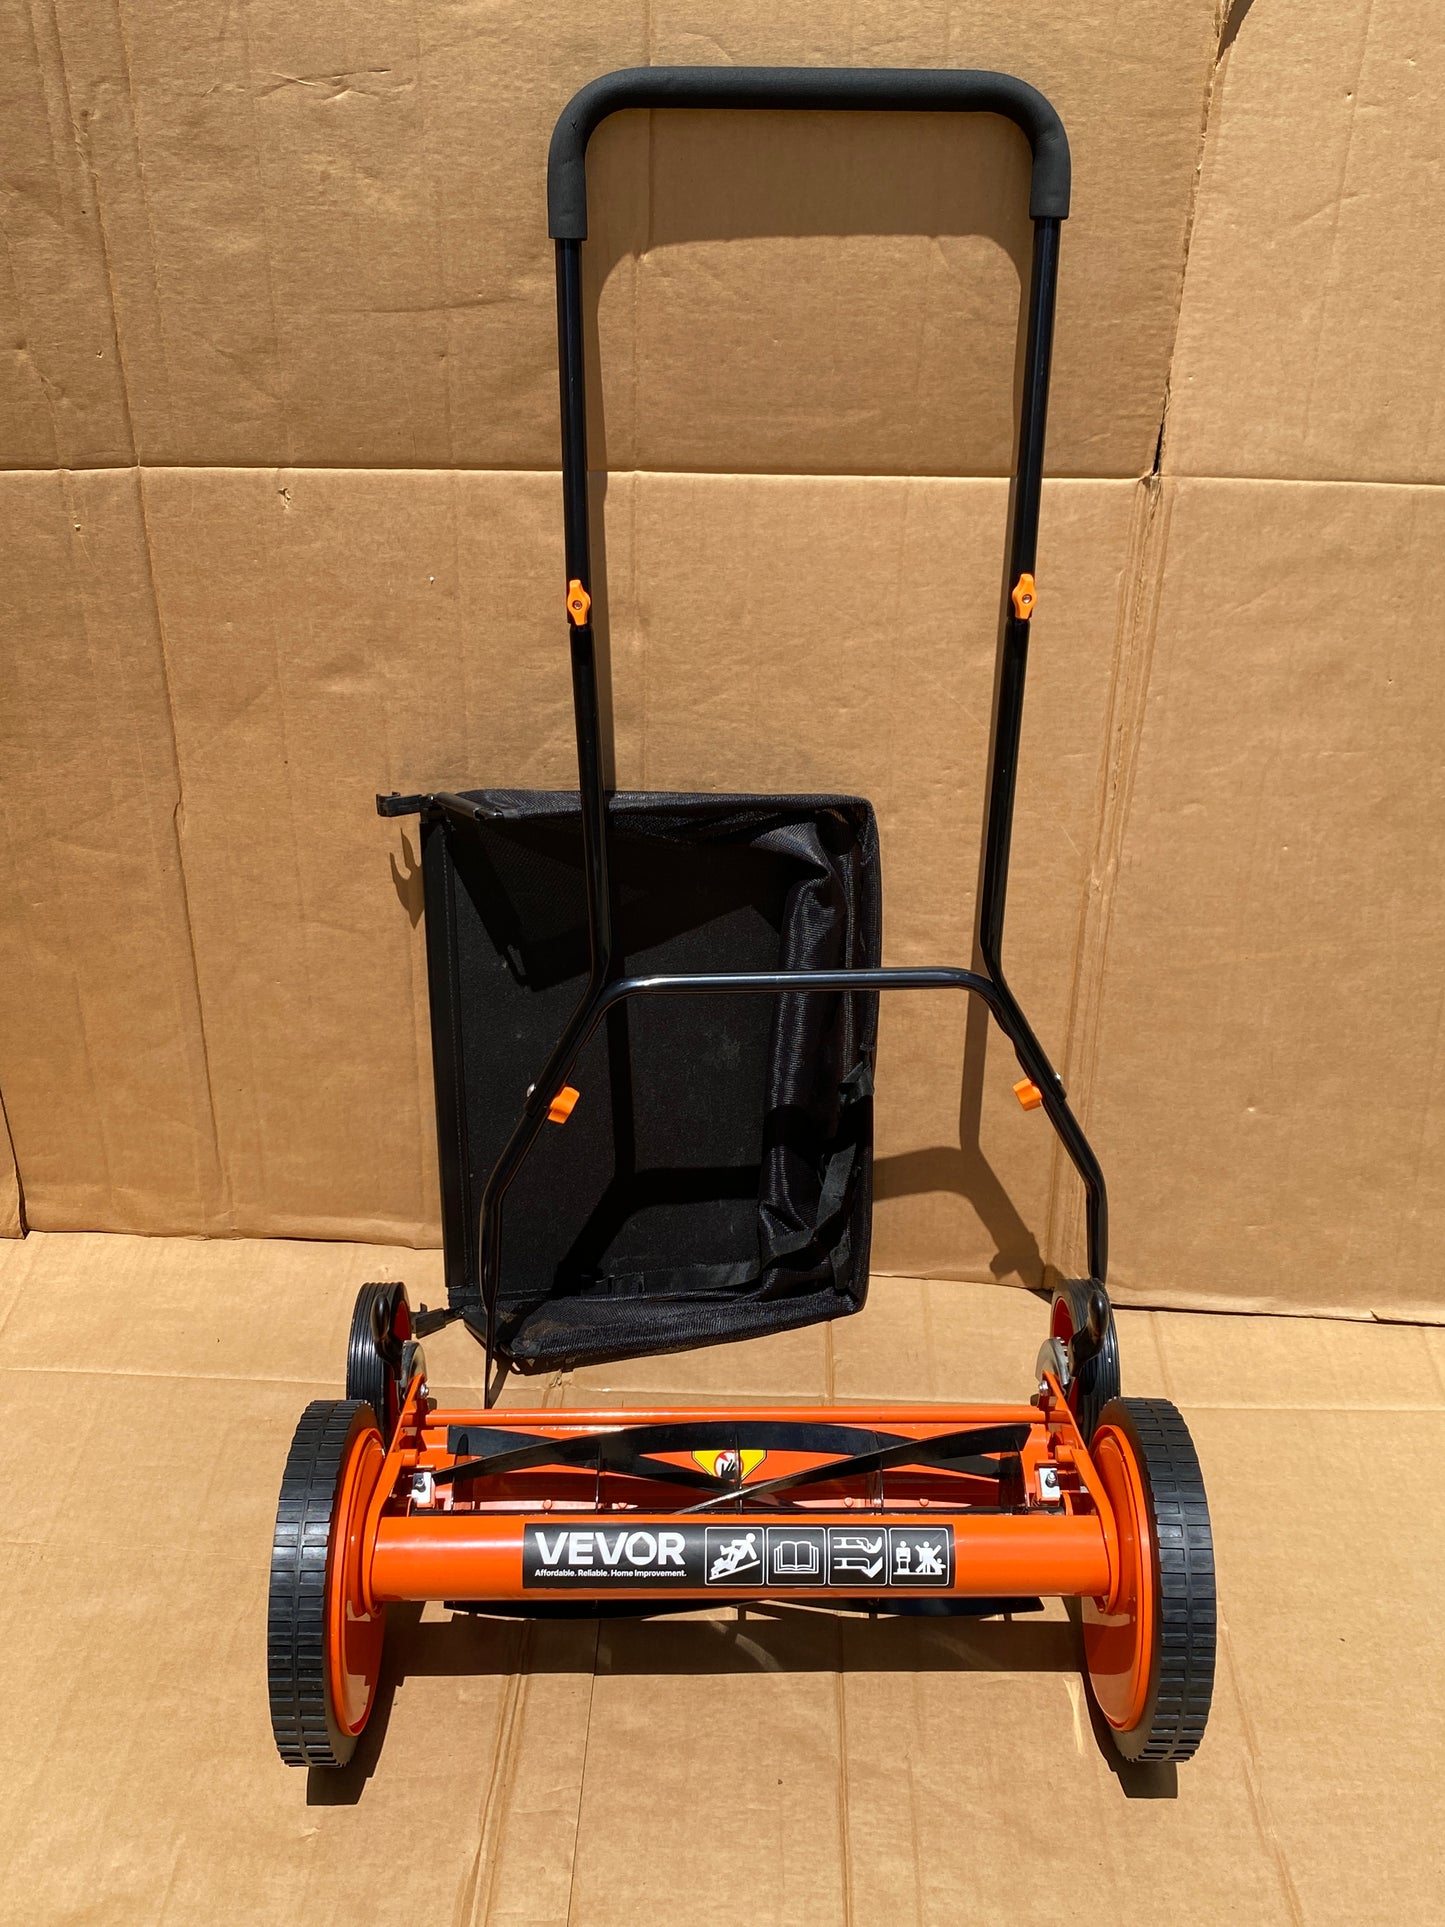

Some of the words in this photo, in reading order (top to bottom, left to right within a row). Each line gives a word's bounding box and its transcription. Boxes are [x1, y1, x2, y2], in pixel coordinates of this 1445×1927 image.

[534, 1531, 686, 1565] VEVOR
[535, 1568, 577, 1577] Affordable.
[578, 1568, 610, 1577] Reliable.
[611, 1569, 634, 1577] Home
[634, 1569, 687, 1579] Improvement.
